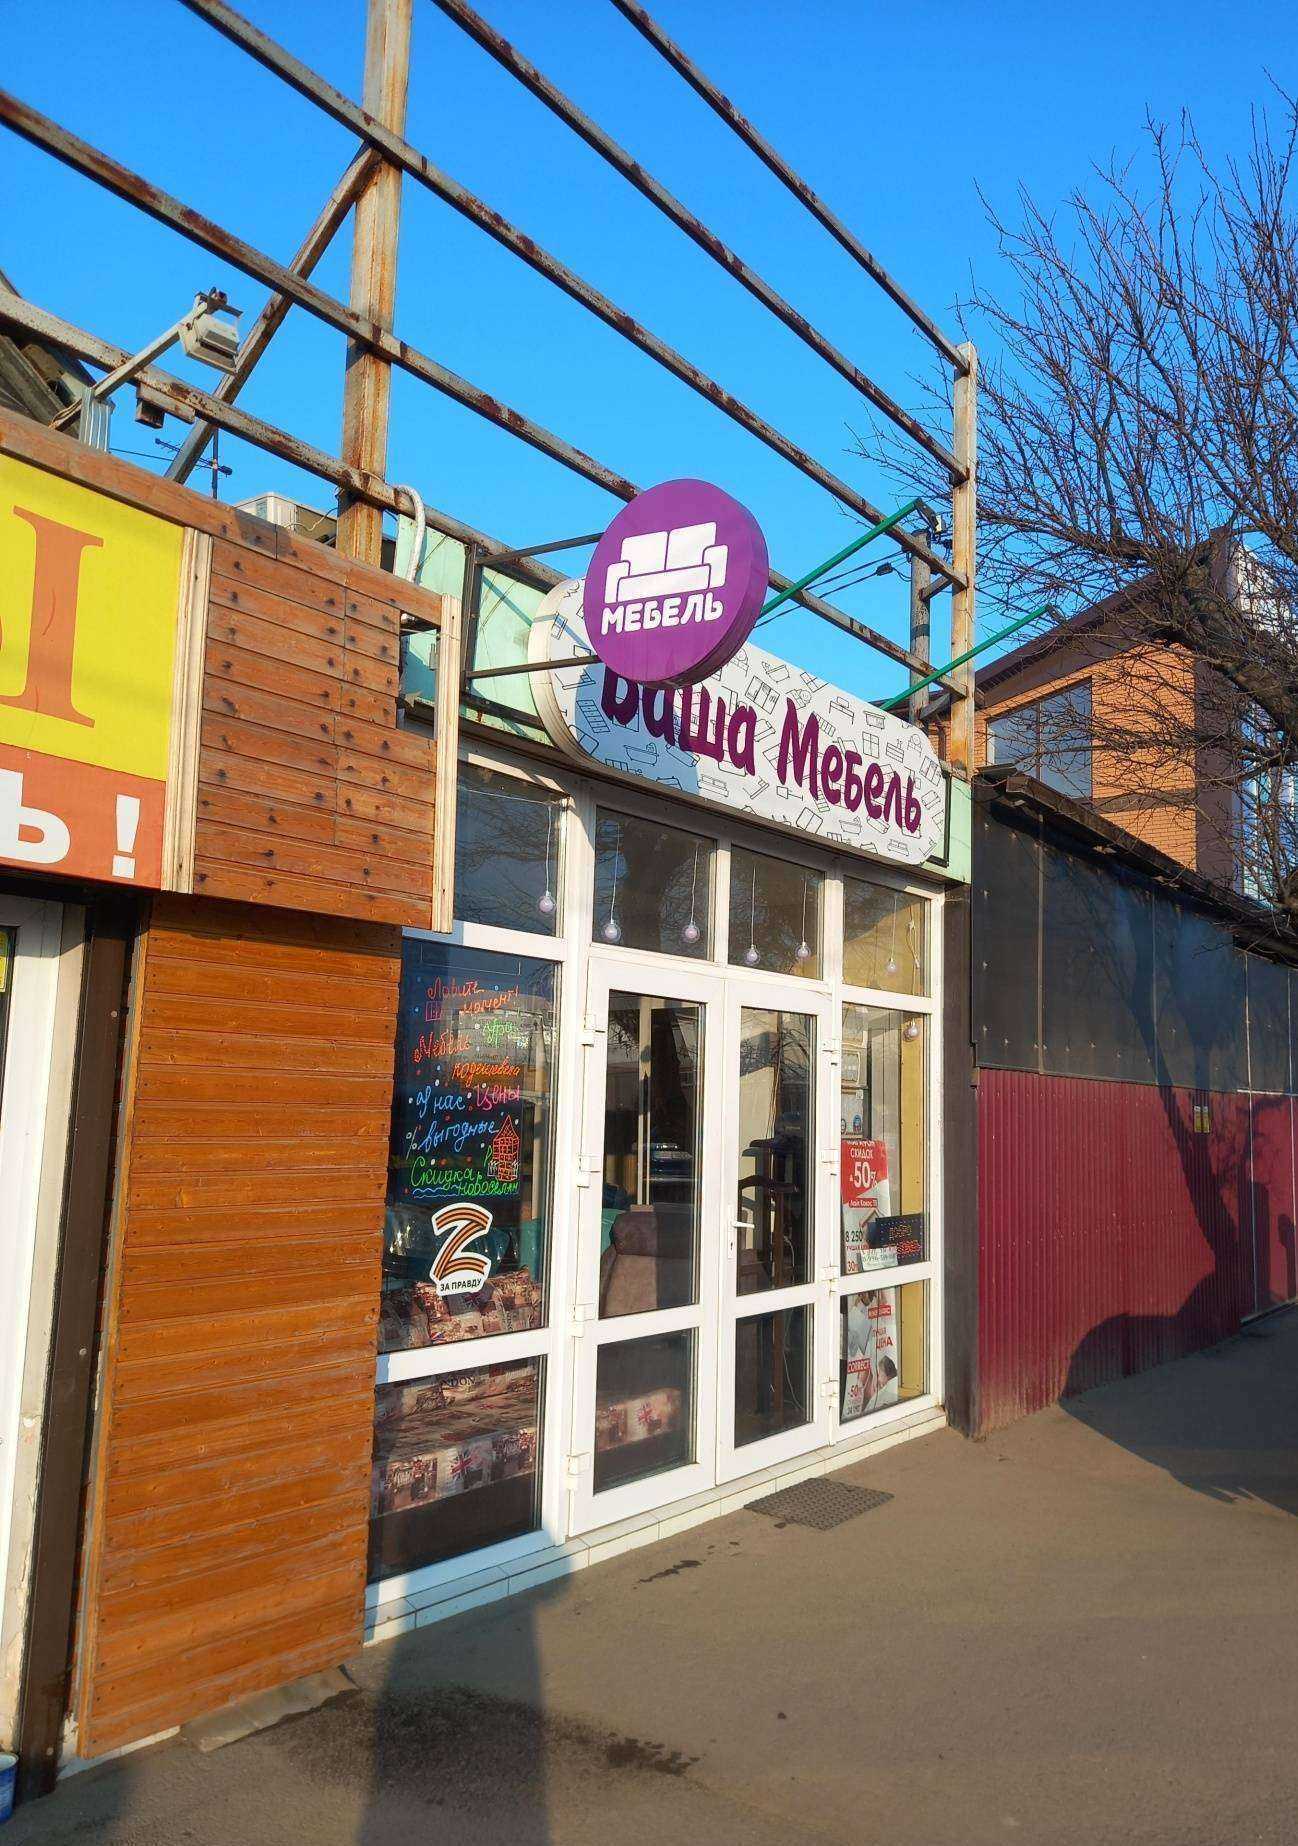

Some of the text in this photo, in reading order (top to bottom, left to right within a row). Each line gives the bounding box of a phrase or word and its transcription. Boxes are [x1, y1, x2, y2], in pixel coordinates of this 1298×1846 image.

[600, 592, 725, 636] МЕБЕЛЬ
[777, 696, 922, 835] Мебель
[433, 1095, 465, 1114] нас
[440, 1278, 482, 1292] ЗА ПРАВДУ
